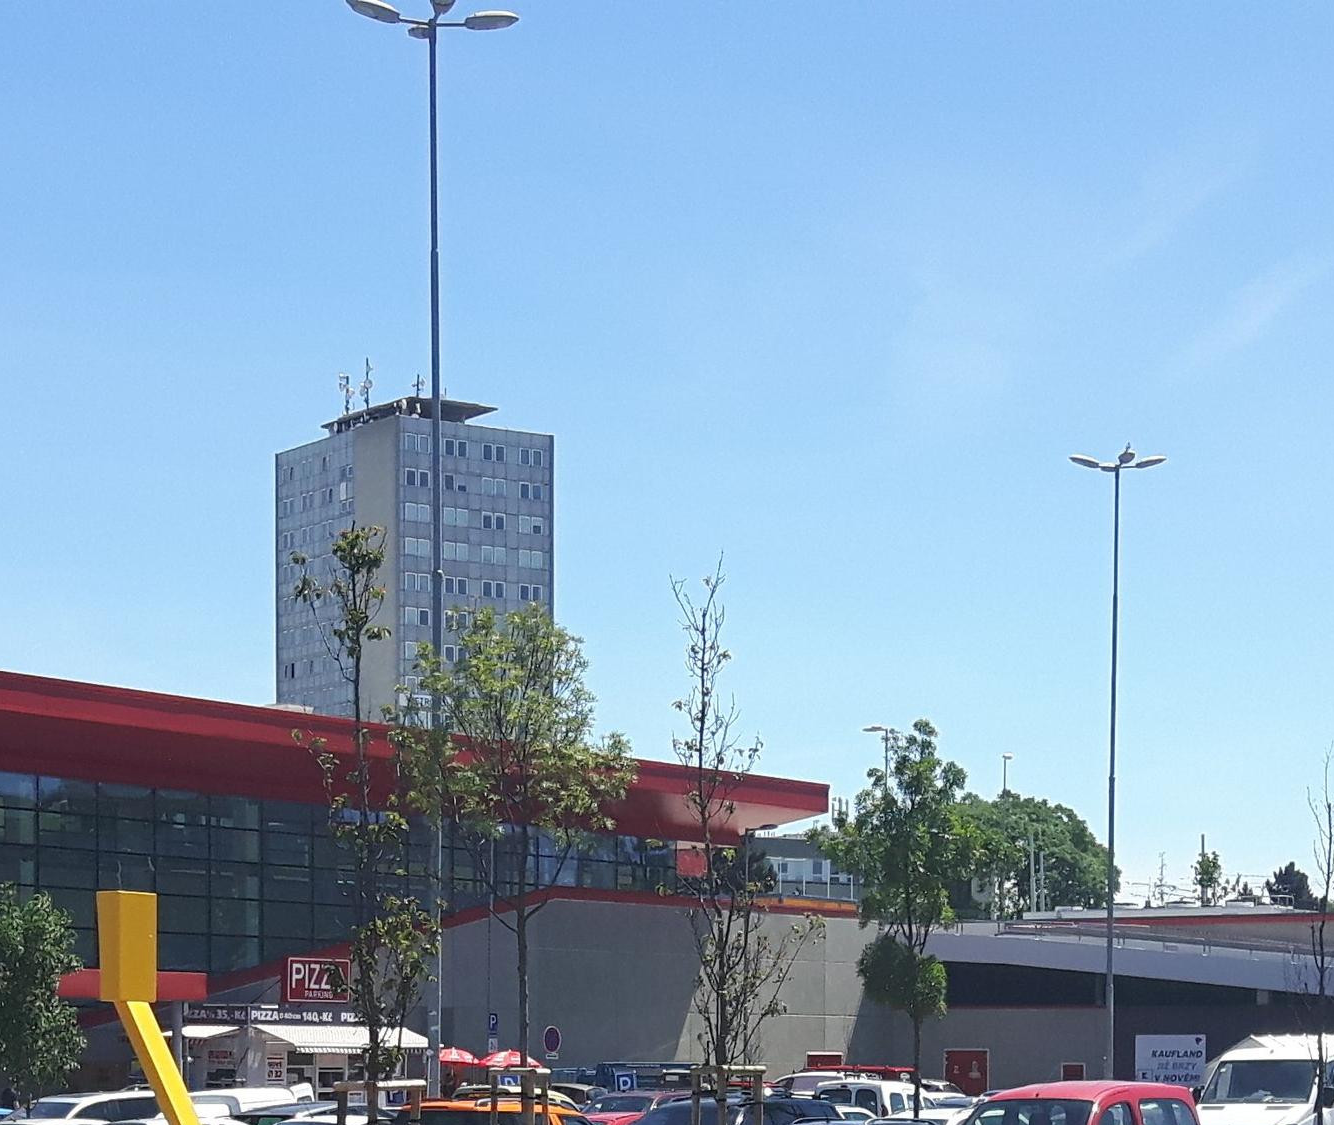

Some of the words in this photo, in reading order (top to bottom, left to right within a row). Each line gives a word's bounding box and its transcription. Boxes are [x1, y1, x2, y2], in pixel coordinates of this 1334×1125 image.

[251, 1010, 280, 1021] PIZZA
[490, 1015, 497, 1026] P
[1151, 1050, 1203, 1058] KAUFLAND
